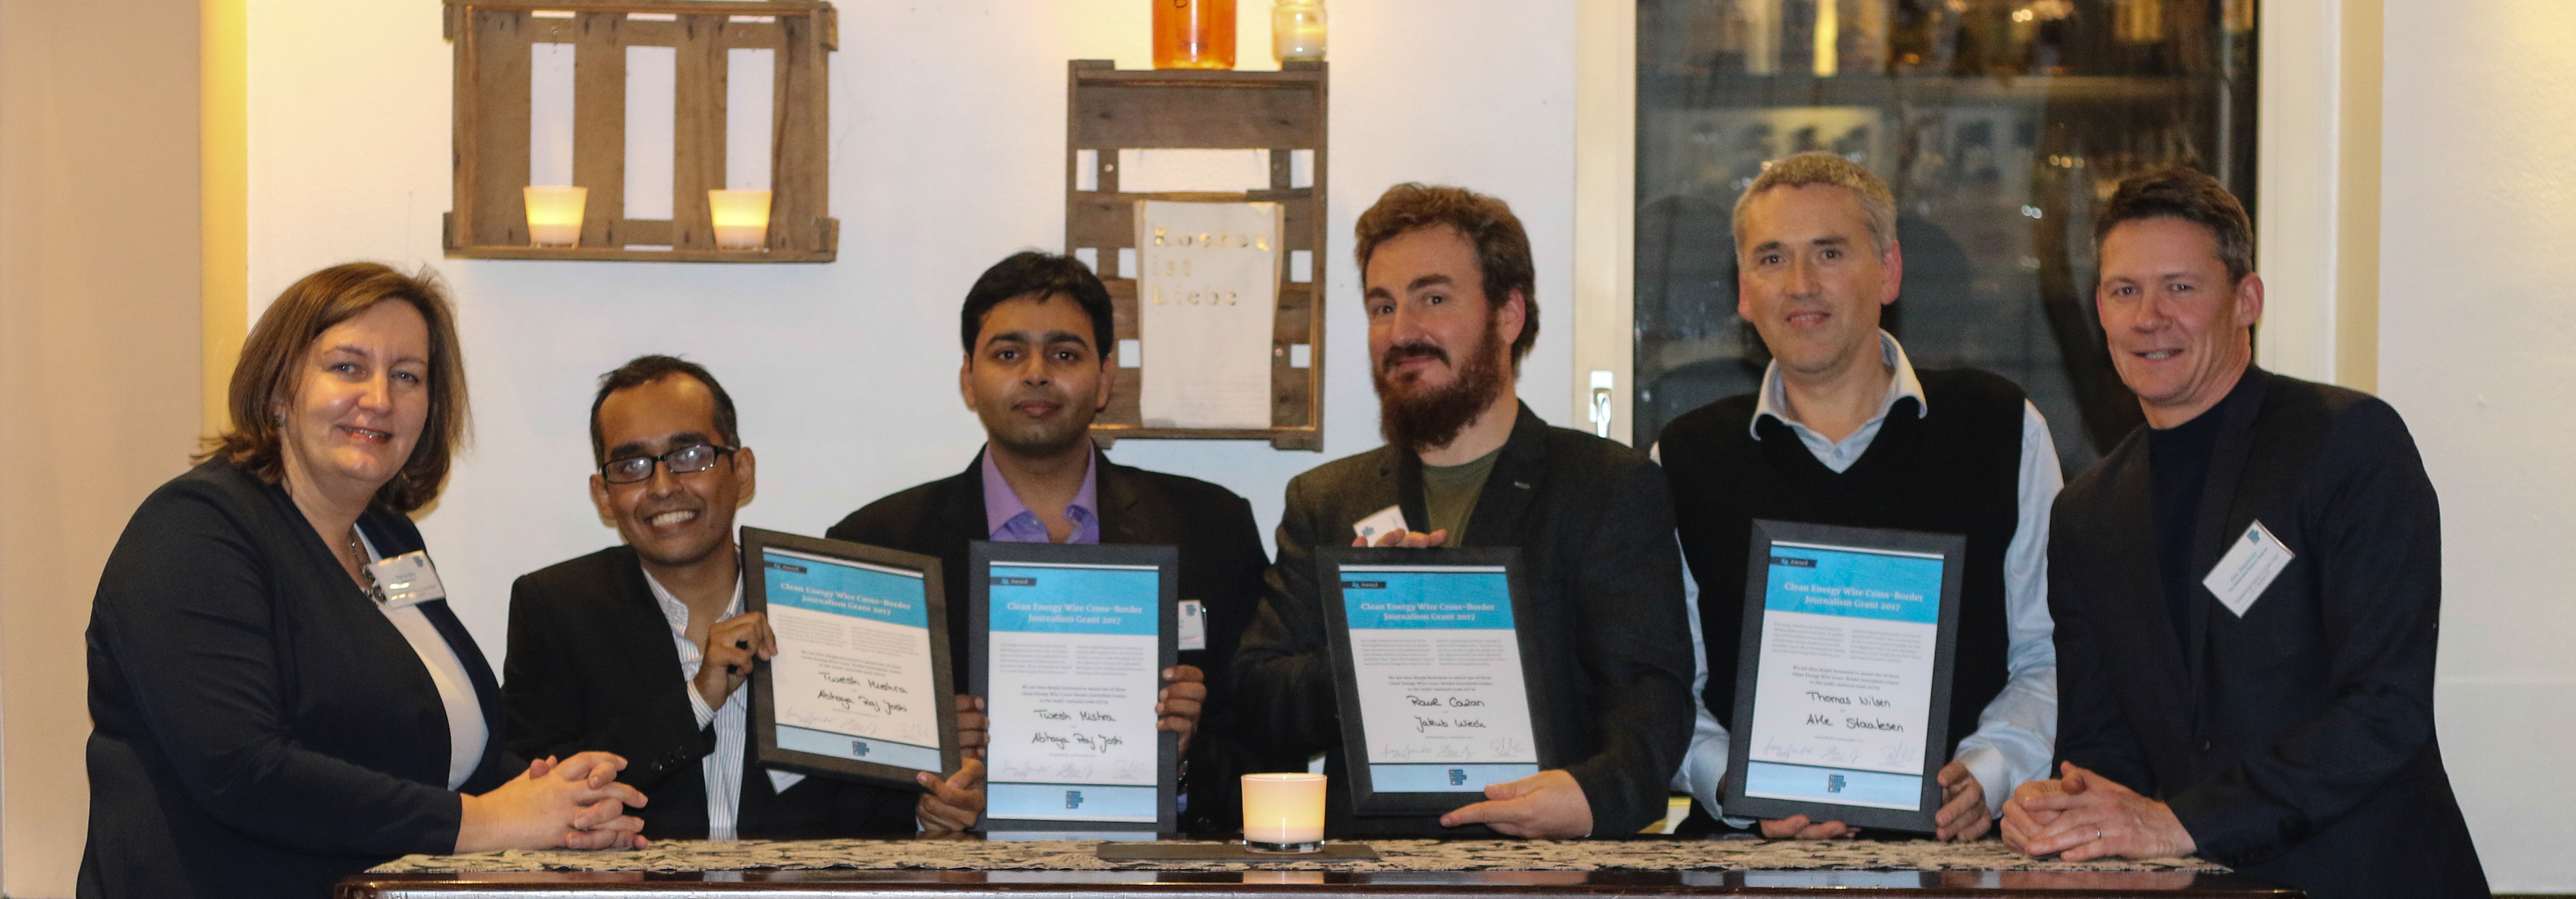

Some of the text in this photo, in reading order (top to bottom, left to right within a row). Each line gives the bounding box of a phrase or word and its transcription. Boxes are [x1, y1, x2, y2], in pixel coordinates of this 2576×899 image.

[1151, 284, 1237, 306] Liebe
[781, 582, 911, 610] Clean Energy Wire Cross-Border
[1785, 582, 1924, 602] Clean Energy Wire Cross-Border
[802, 594, 892, 616] Journalism Grant 2017
[1007, 602, 1143, 614] Clean Energy Wire Cross-Border
[1387, 603, 1416, 612] Energy
[1417, 602, 1437, 610] Wire
[1805, 595, 1901, 611] Journalism Grant 2017
[1028, 614, 1122, 625] Journalism Grant 2017
[1384, 612, 1430, 620] Journalism
[1806, 691, 1891, 707] Thomas Nilsen
[1415, 715, 1449, 733] Jakub
[1032, 732, 1123, 754] Abhaya Raj Joshi
